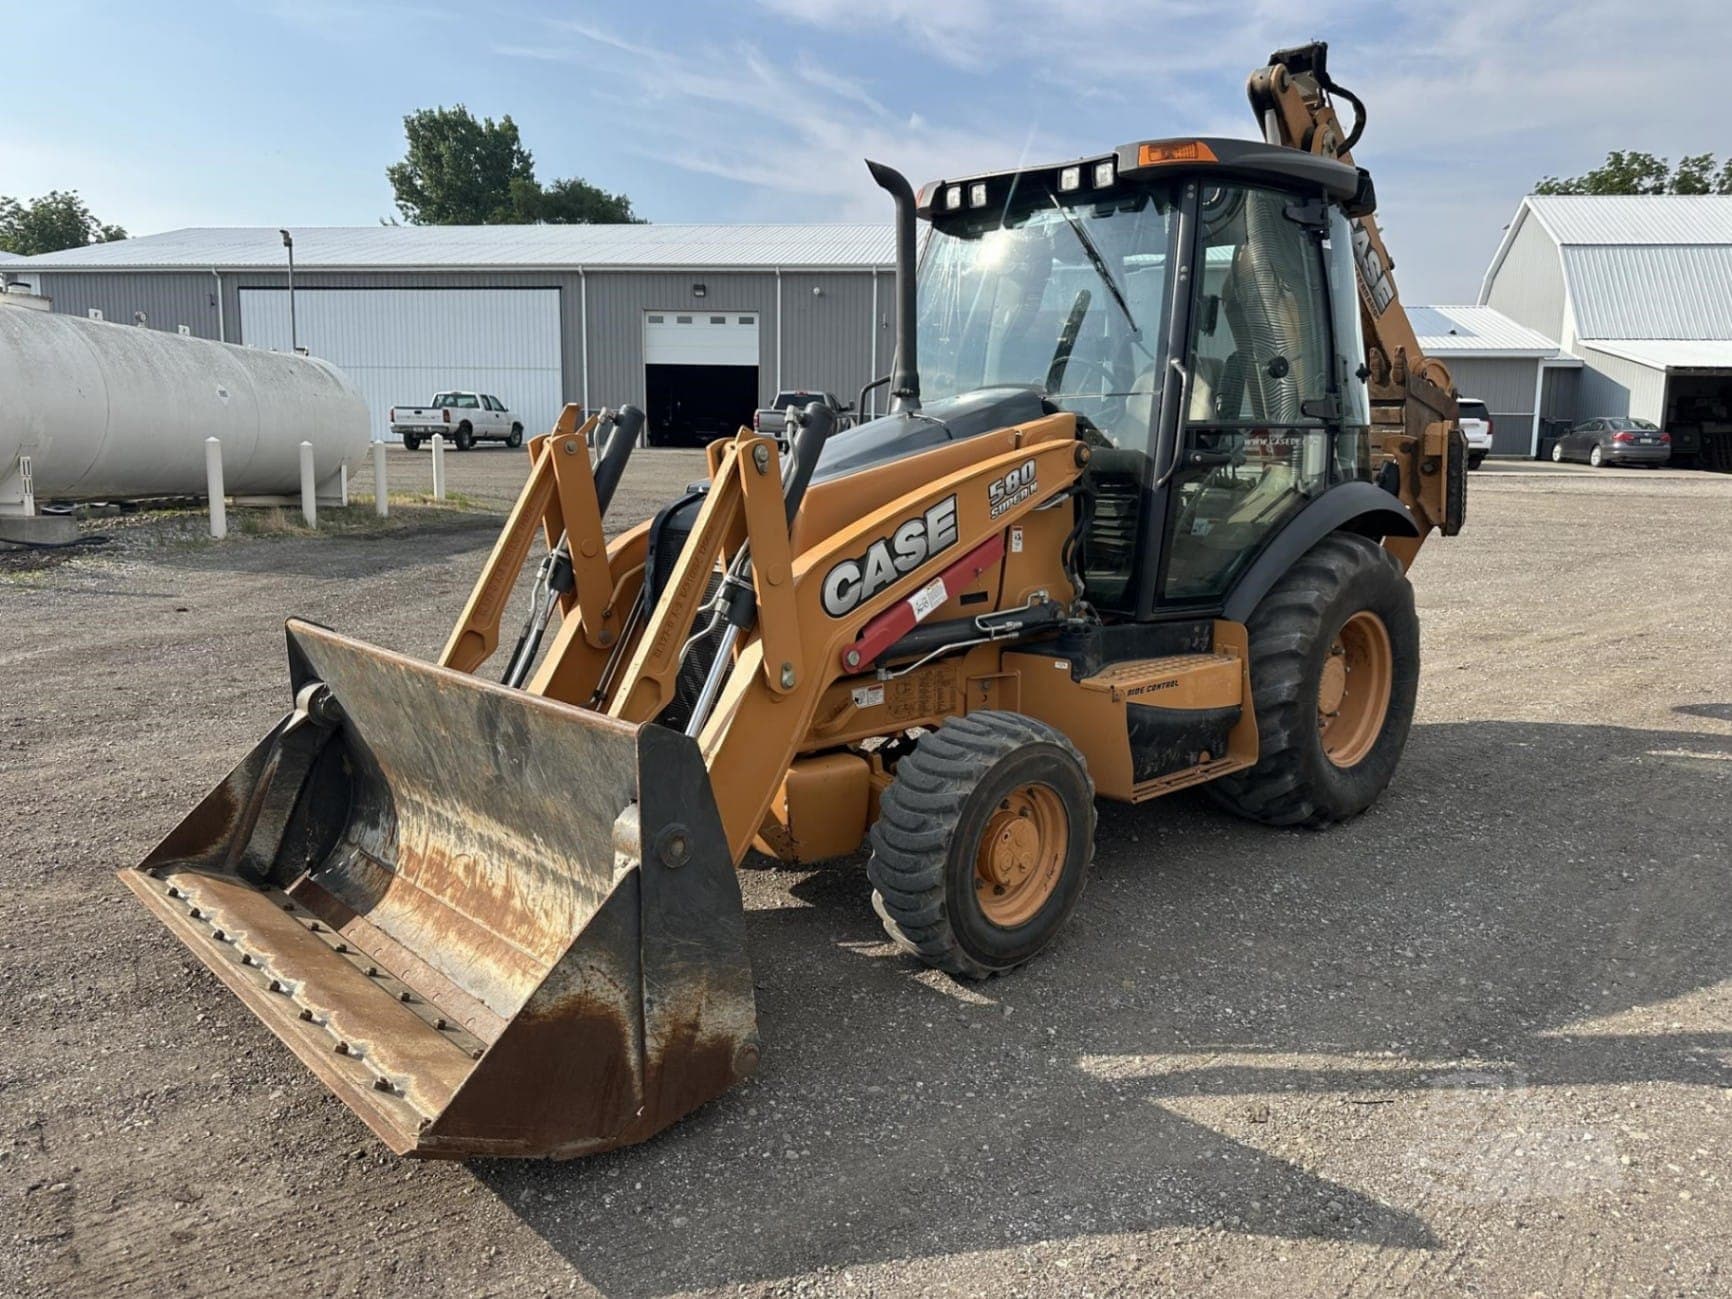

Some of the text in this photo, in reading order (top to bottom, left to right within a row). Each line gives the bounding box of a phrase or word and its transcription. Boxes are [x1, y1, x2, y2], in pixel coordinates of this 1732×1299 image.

[1350, 217, 1395, 315] ASE
[988, 459, 1037, 506] 580
[821, 494, 960, 618] CASE
[1146, 680, 1179, 692] CONTROL
